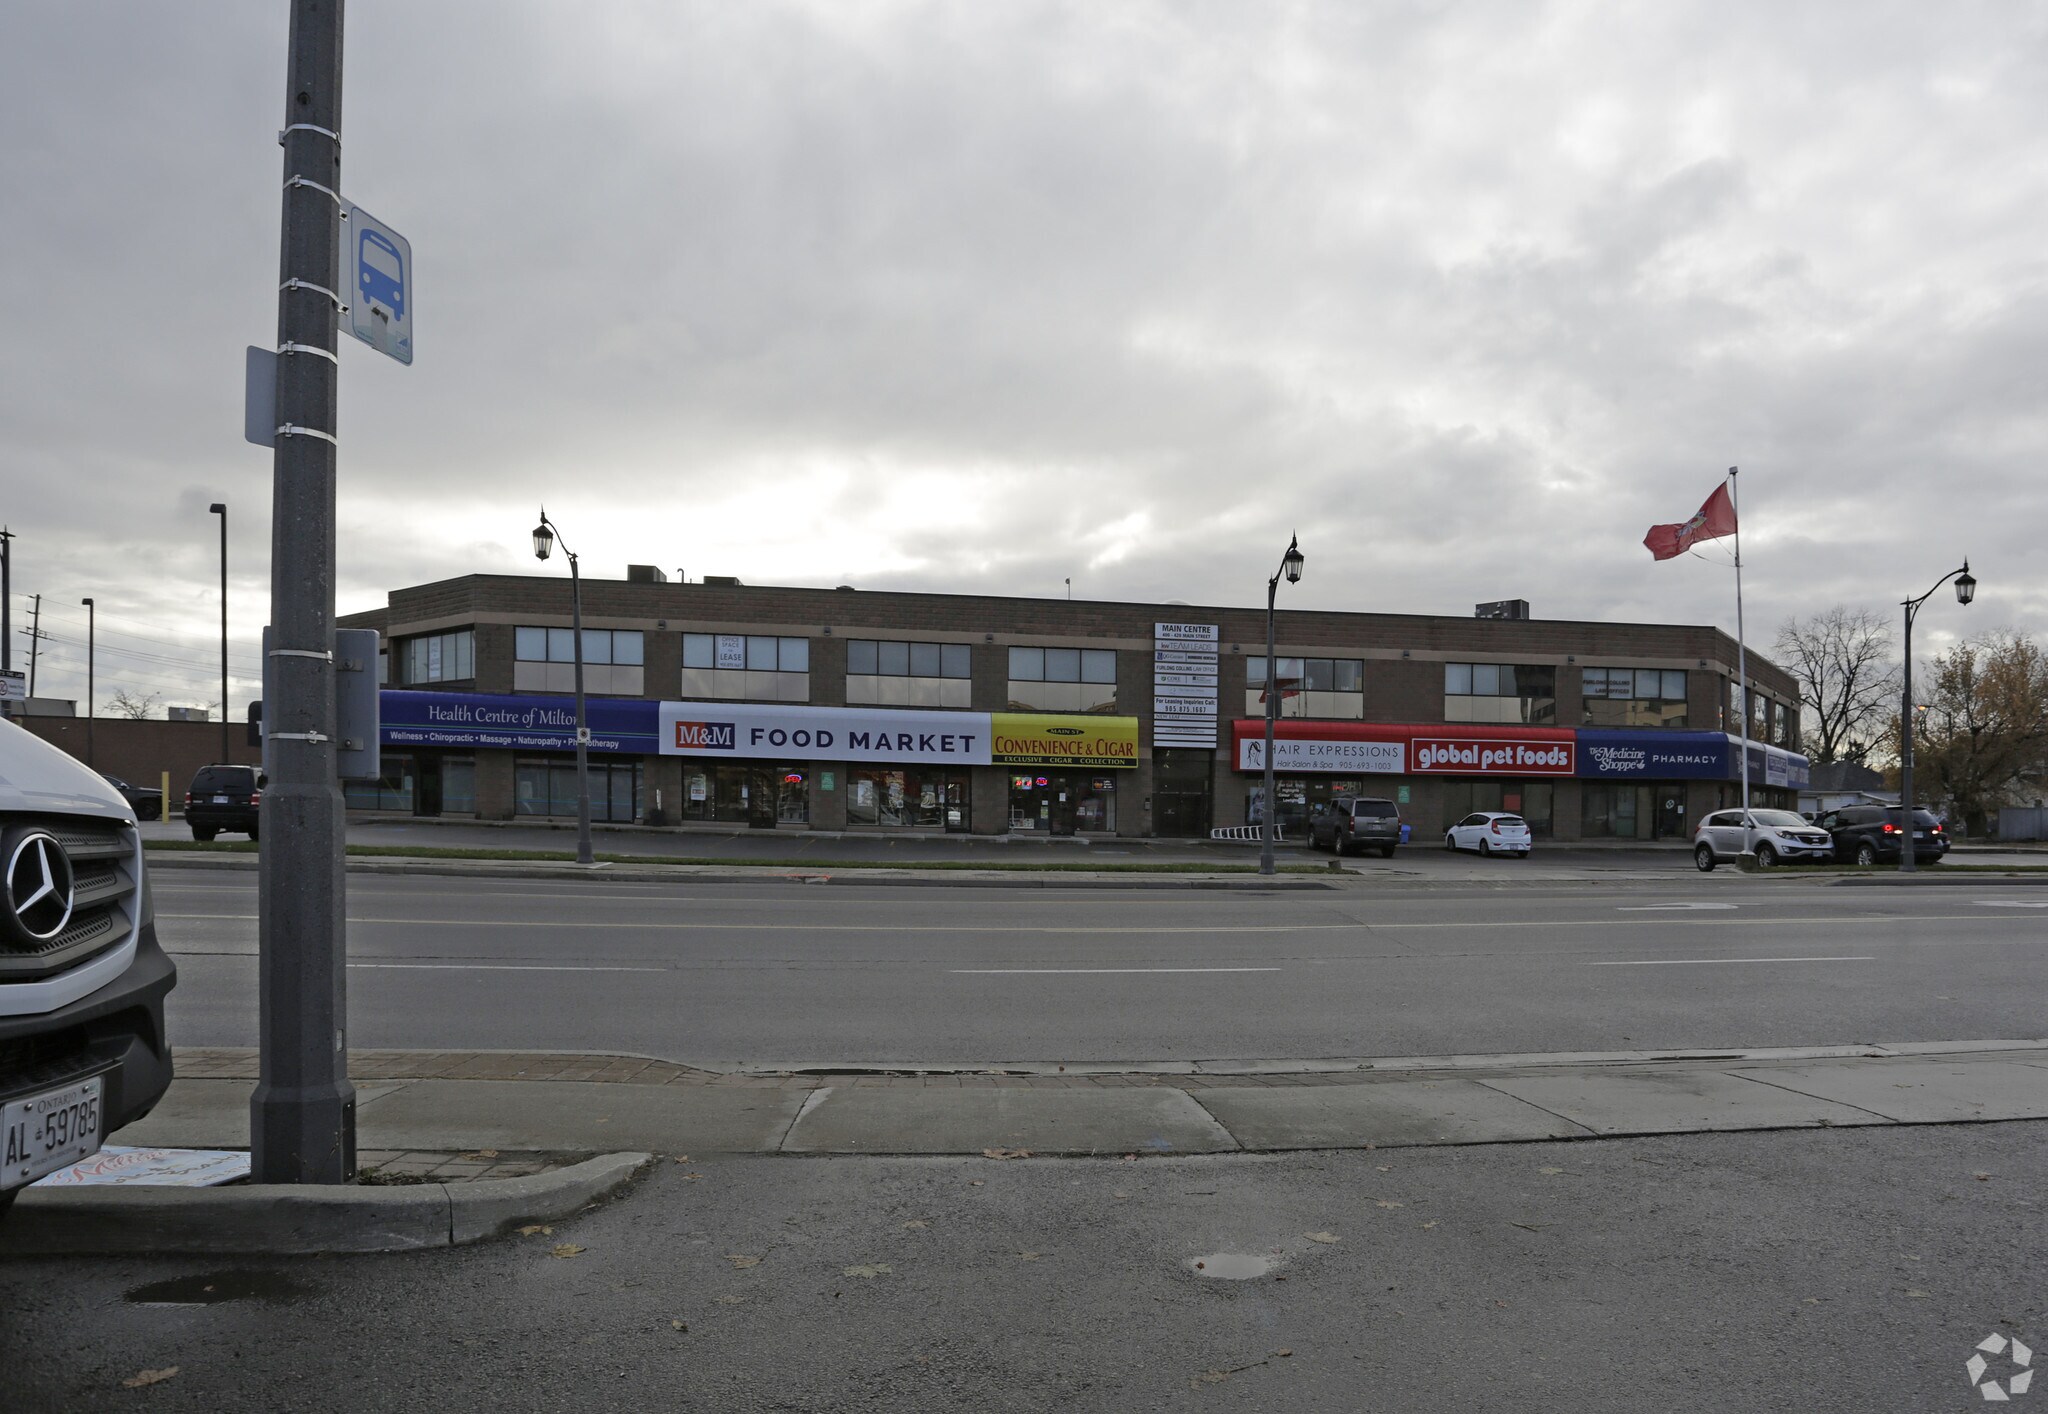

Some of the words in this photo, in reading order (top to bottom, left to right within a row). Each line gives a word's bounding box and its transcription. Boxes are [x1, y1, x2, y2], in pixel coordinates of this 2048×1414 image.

[429, 705, 472, 722] Health
[475, 708, 519, 723] Centre
[522, 708, 537, 728] of
[390, 731, 423, 741] Wellness
[430, 733, 474, 743] Chiropractic
[480, 735, 512, 746] Massage
[518, 736, 562, 747] Naturopathy
[568, 738, 619, 749] Phiotherapy
[678, 725, 732, 745] M&M
[750, 728, 834, 748] FOOD
[850, 732, 976, 753] MARKET
[995, 736, 1083, 755] CONVENIENCE
[1086, 744, 1093, 755] &
[1096, 738, 1133, 756] CIGAR
[1310, 745, 1399, 757] EXPRESSIONS
[1595, 747, 1645, 761] Medicine
[1292, 760, 1311, 768] Salon
[1320, 761, 1333, 769] Spa
[1339, 761, 1391, 770] 905-693-1003
[1418, 744, 1478, 768] global
[1481, 747, 1513, 769] pet
[1516, 746, 1568, 766] foods
[1599, 757, 1636, 771] Shoppe
[1653, 755, 1717, 764] PHARMACY
[38, 1092, 76, 1113] ONTARIO
[6, 1122, 31, 1166] AL
[46, 1097, 97, 1150] 59785
